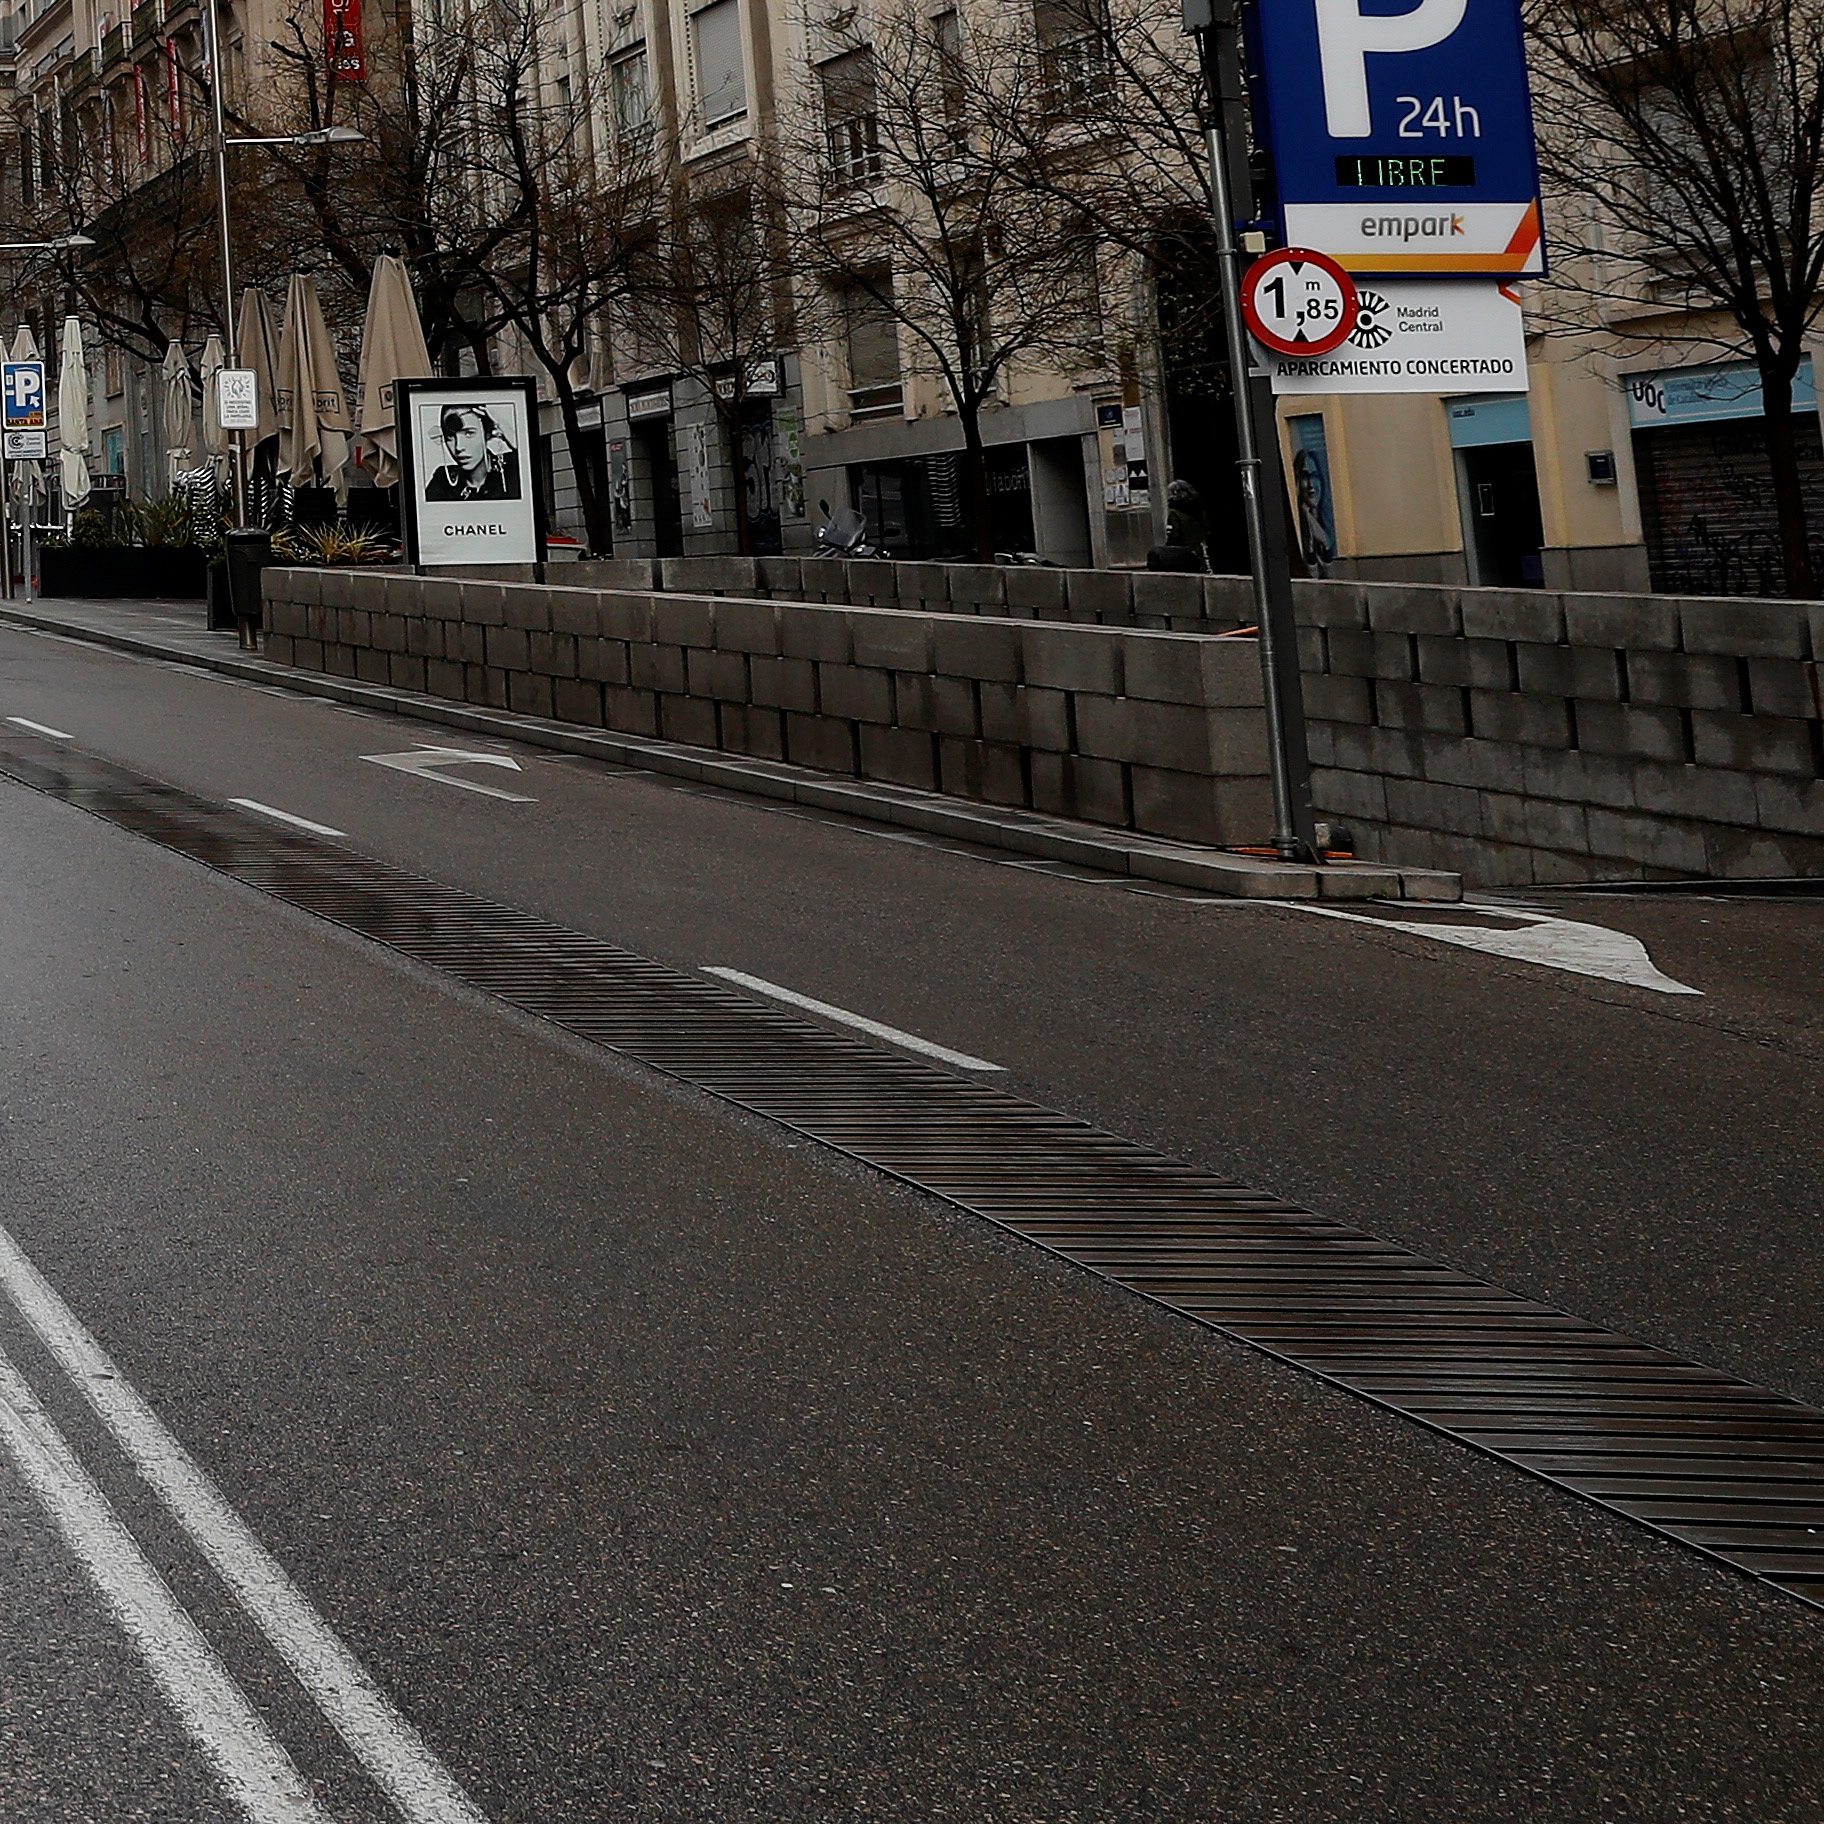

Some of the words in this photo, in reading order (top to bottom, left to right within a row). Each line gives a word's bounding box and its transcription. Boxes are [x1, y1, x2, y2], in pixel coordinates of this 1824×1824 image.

[1395, 95, 1481, 139] 24h
[1357, 158, 1446, 187] LIBRE
[1360, 211, 1465, 242] empark
[1305, 280, 1321, 291] m
[1397, 306, 1439, 318] Madrid
[1398, 321, 1444, 333] Central
[1276, 360, 1402, 377] APARCAMIENTO
[1406, 359, 1514, 375] CONCERTADO
[15, 371, 40, 407] P
[443, 523, 507, 536] CHANEL
